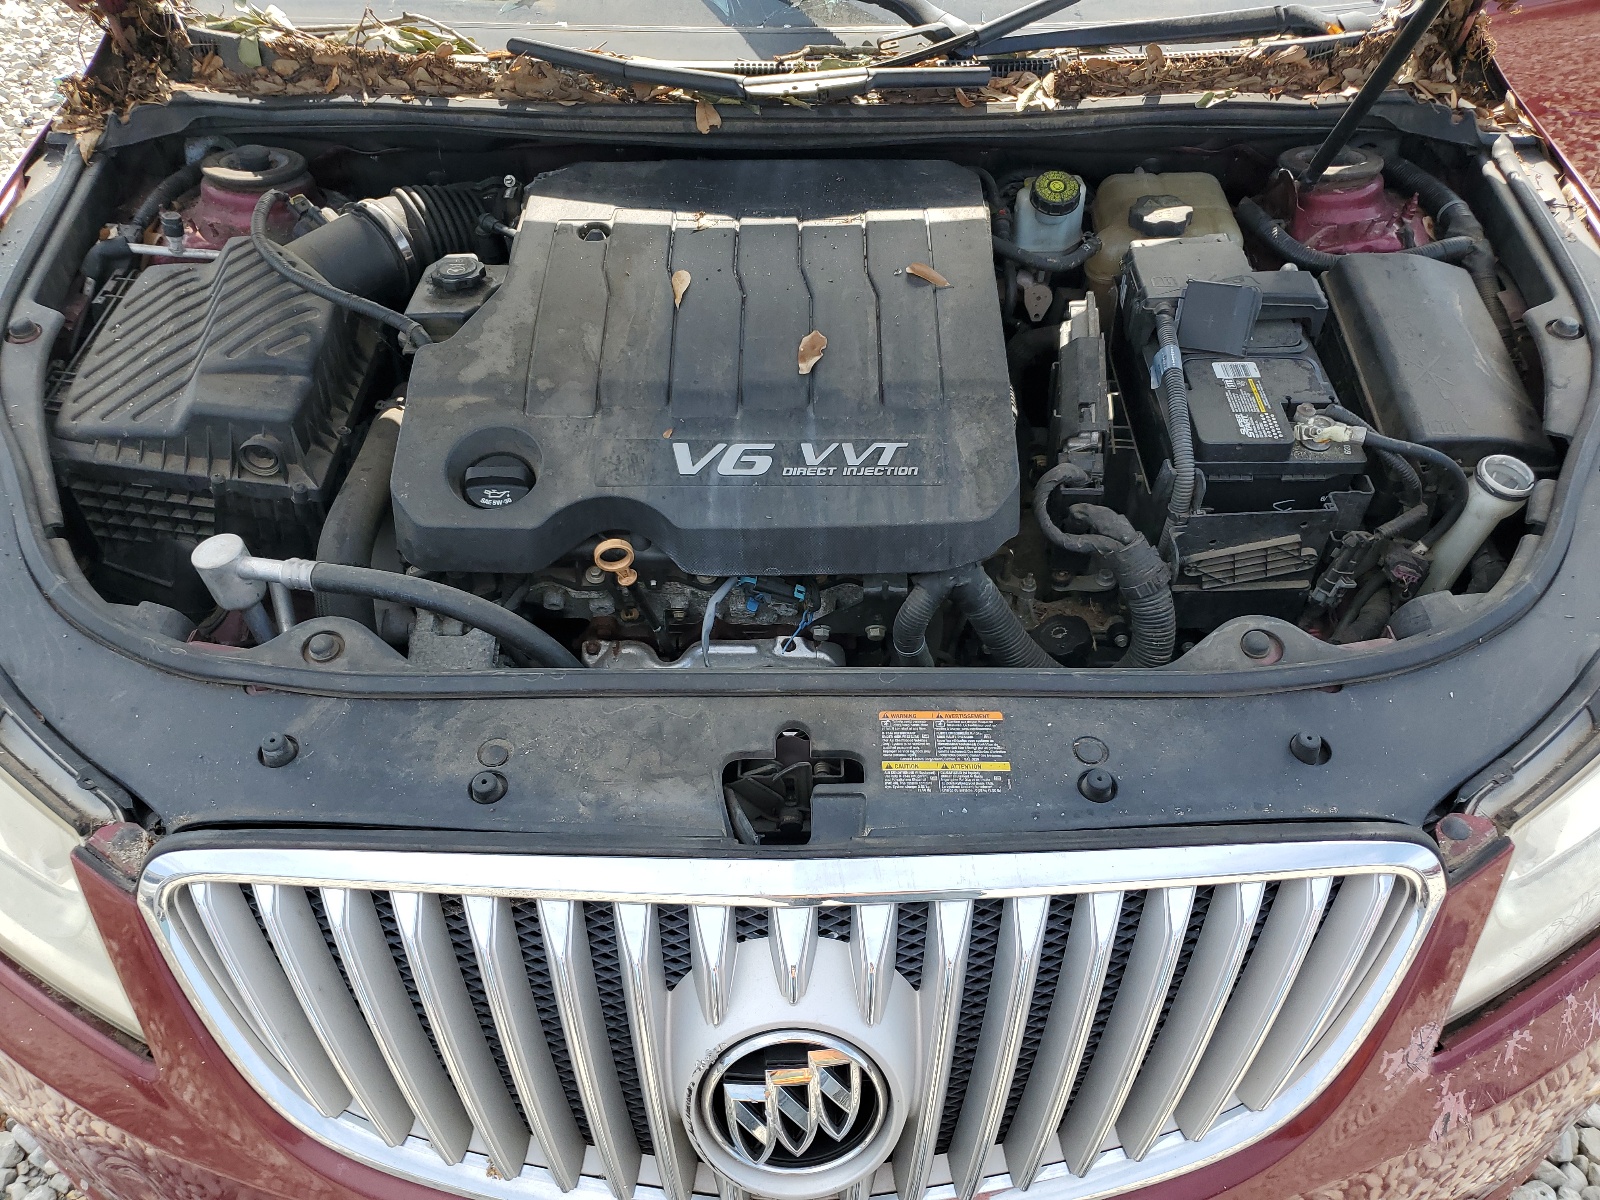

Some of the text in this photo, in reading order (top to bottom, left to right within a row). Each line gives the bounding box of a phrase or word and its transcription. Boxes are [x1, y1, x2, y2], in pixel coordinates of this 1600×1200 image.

[672, 443, 909, 476] V6 VVT
[782, 466, 919, 476] DIRECT INJECTION
[480, 497, 492, 505] SAE
